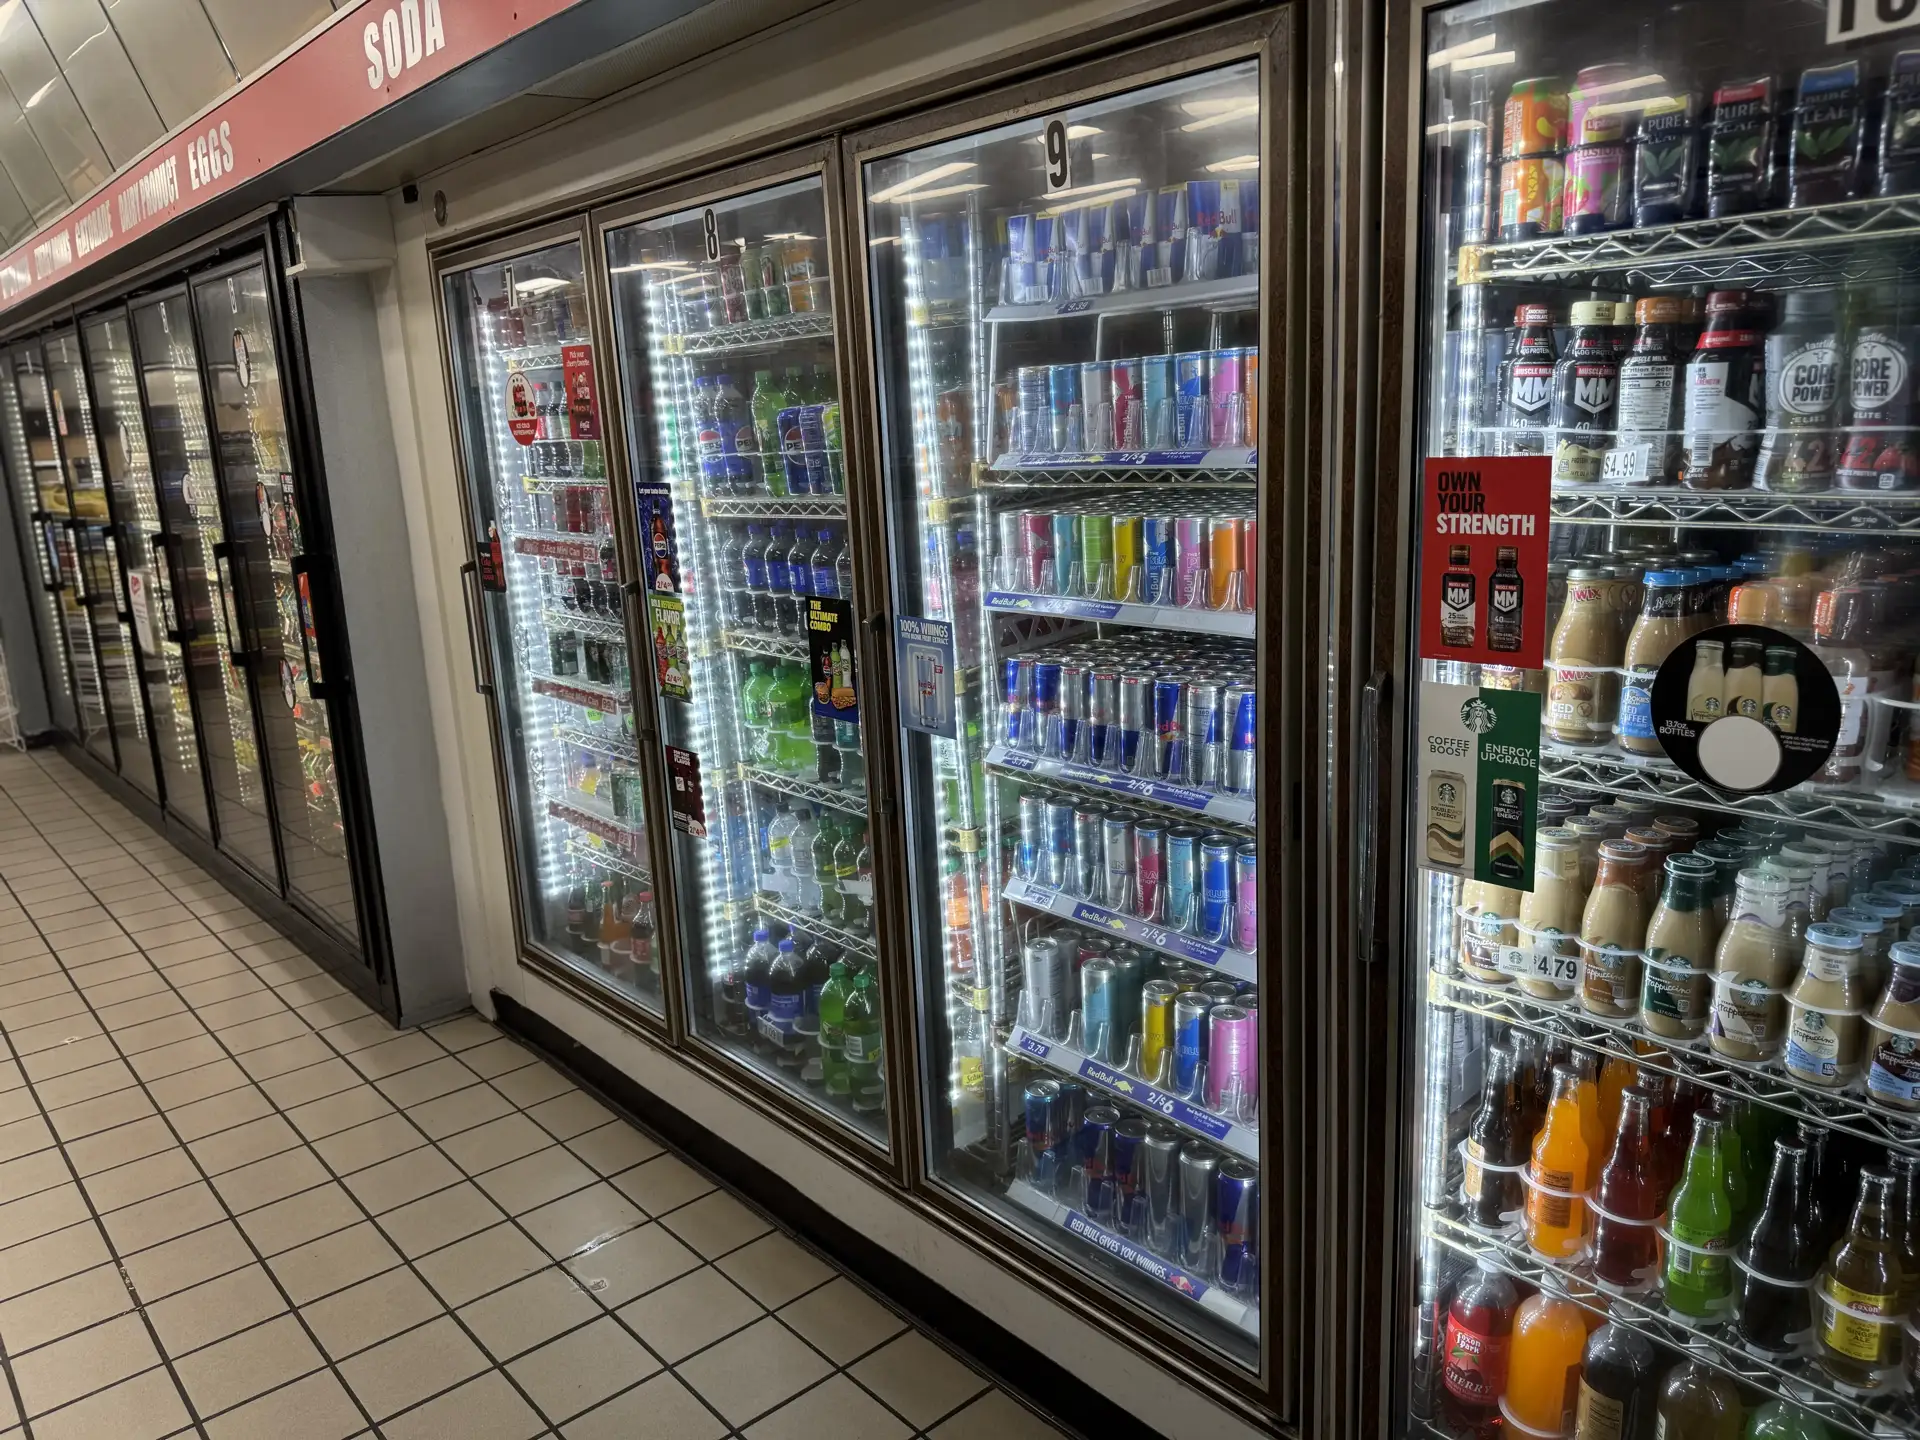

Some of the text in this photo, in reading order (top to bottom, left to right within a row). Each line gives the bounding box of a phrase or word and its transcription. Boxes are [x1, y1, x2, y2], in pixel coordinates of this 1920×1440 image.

[363, 0, 446, 89] SODA
[1716, 102, 1759, 119] PURE
[1648, 114, 1681, 130] PURE
[187, 120, 234, 191] EGGS
[1046, 120, 1068, 187] 9
[1218, 209, 1237, 225] Bull
[704, 208, 718, 260] 8
[505, 266, 515, 307] 7
[1515, 366, 1538, 375] MUSCLE
[1579, 367, 1602, 376] MUSCLE
[1795, 362, 1839, 386] CORE
[1854, 357, 1892, 380] CORE
[1791, 384, 1835, 402] POWER
[1852, 380, 1889, 397] POWER
[1513, 418, 1528, 429] 40
[1575, 421, 1590, 431] 40
[1119, 452, 1148, 465] 2/$5
[1784, 440, 1826, 472] 42
[1840, 436, 1878, 469] 42
[1603, 452, 1636, 477] $4.99
[1437, 471, 1481, 492] OWN
[1437, 492, 1485, 513] YOUR
[1436, 513, 1536, 536] STRENGTH
[569, 547, 581, 556] Can
[654, 541, 667, 549] PEPSI
[810, 600, 821, 610] THE
[655, 607, 681, 626] FLAVOR
[810, 610, 838, 623] ULTIMATE
[1448, 612, 1457, 620] 25
[809, 621, 832, 633] COMBO
[900, 619, 919, 634] 100%
[1659, 726, 1696, 738] BOTTLES
[1427, 735, 1470, 749] COFFEE
[1485, 743, 1532, 758] ENERGY
[1429, 745, 1468, 757] BOOST
[1480, 751, 1537, 768] UPGRADE
[1127, 779, 1154, 796] 2/$6
[1436, 811, 1457, 820] ENERGY
[1496, 812, 1520, 821] ENERGY
[1140, 927, 1167, 946] 2/$6
[1533, 955, 1578, 980] $4.79
[1146, 1091, 1174, 1114] 2/$6
[1070, 1218, 1085, 1233] RED
[1083, 1224, 1100, 1242] BULL
[1099, 1231, 1120, 1253] GIVES
[1120, 1244, 1137, 1262] YOU
[1457, 1332, 1481, 1347] foxon
[1846, 1326, 1879, 1339] GINGER
[1460, 1340, 1480, 1354] park
[1445, 1366, 1493, 1394] CHERRY
